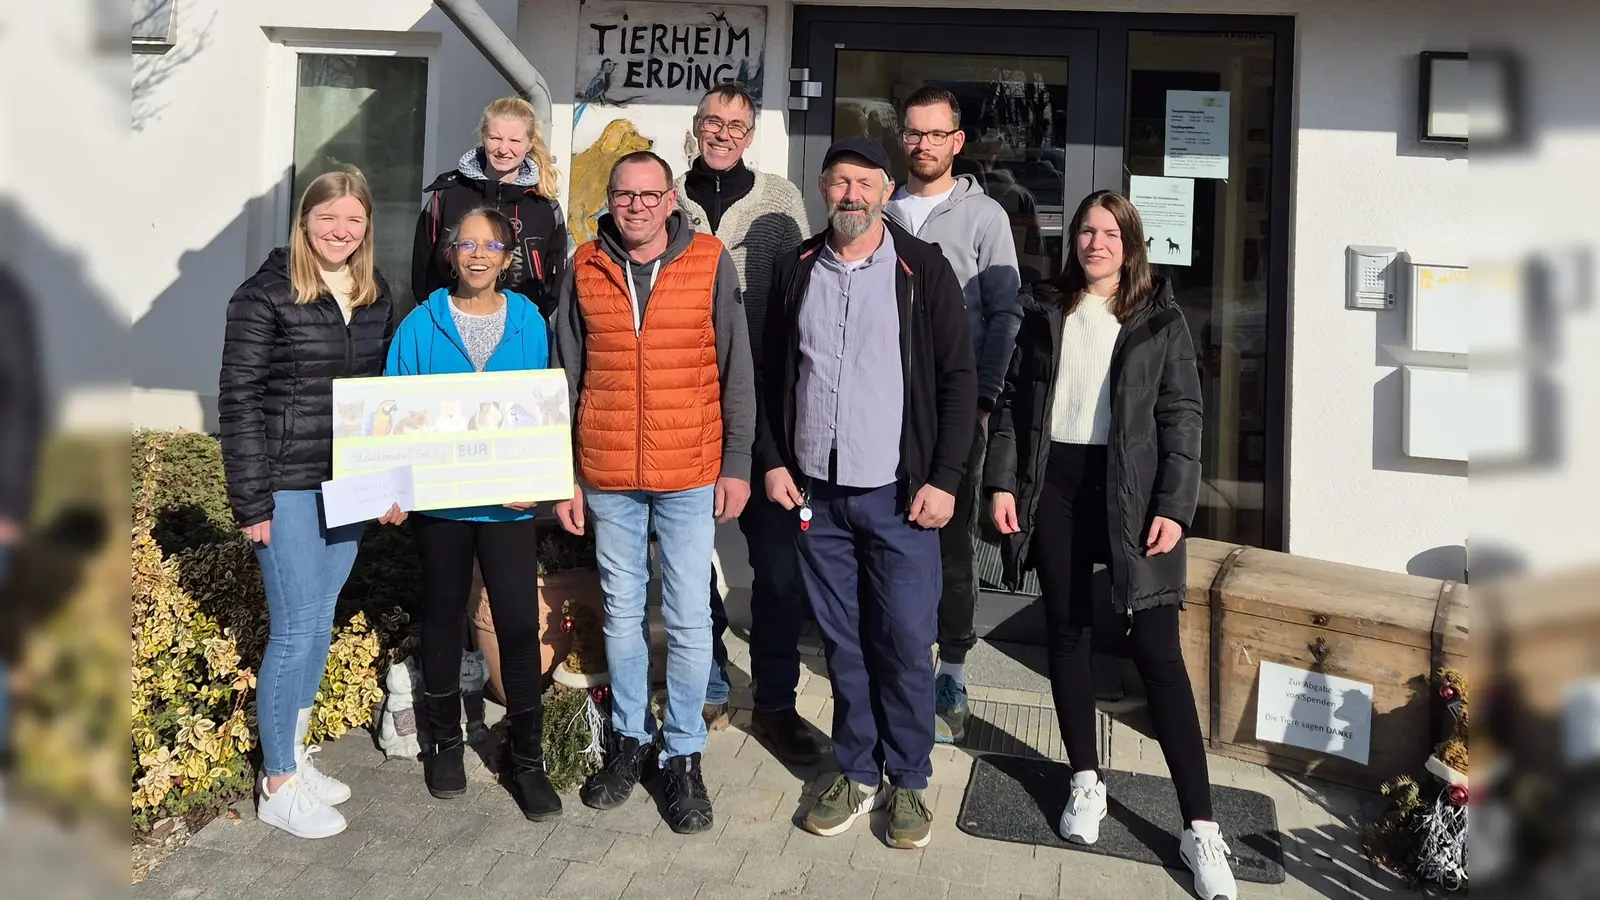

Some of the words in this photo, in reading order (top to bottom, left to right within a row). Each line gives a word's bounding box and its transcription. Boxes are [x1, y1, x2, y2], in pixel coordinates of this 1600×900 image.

[458, 442, 488, 457] EUR
[1288, 677, 1301, 686] Zur
[1303, 681, 1333, 693] Abgabe
[1285, 691, 1300, 700] von
[1301, 694, 1336, 708] Spenden
[1264, 712, 1278, 722] Die
[1280, 715, 1300, 727] Tiere
[1301, 721, 1324, 732] sagen
[1326, 726, 1354, 740] DANKE
